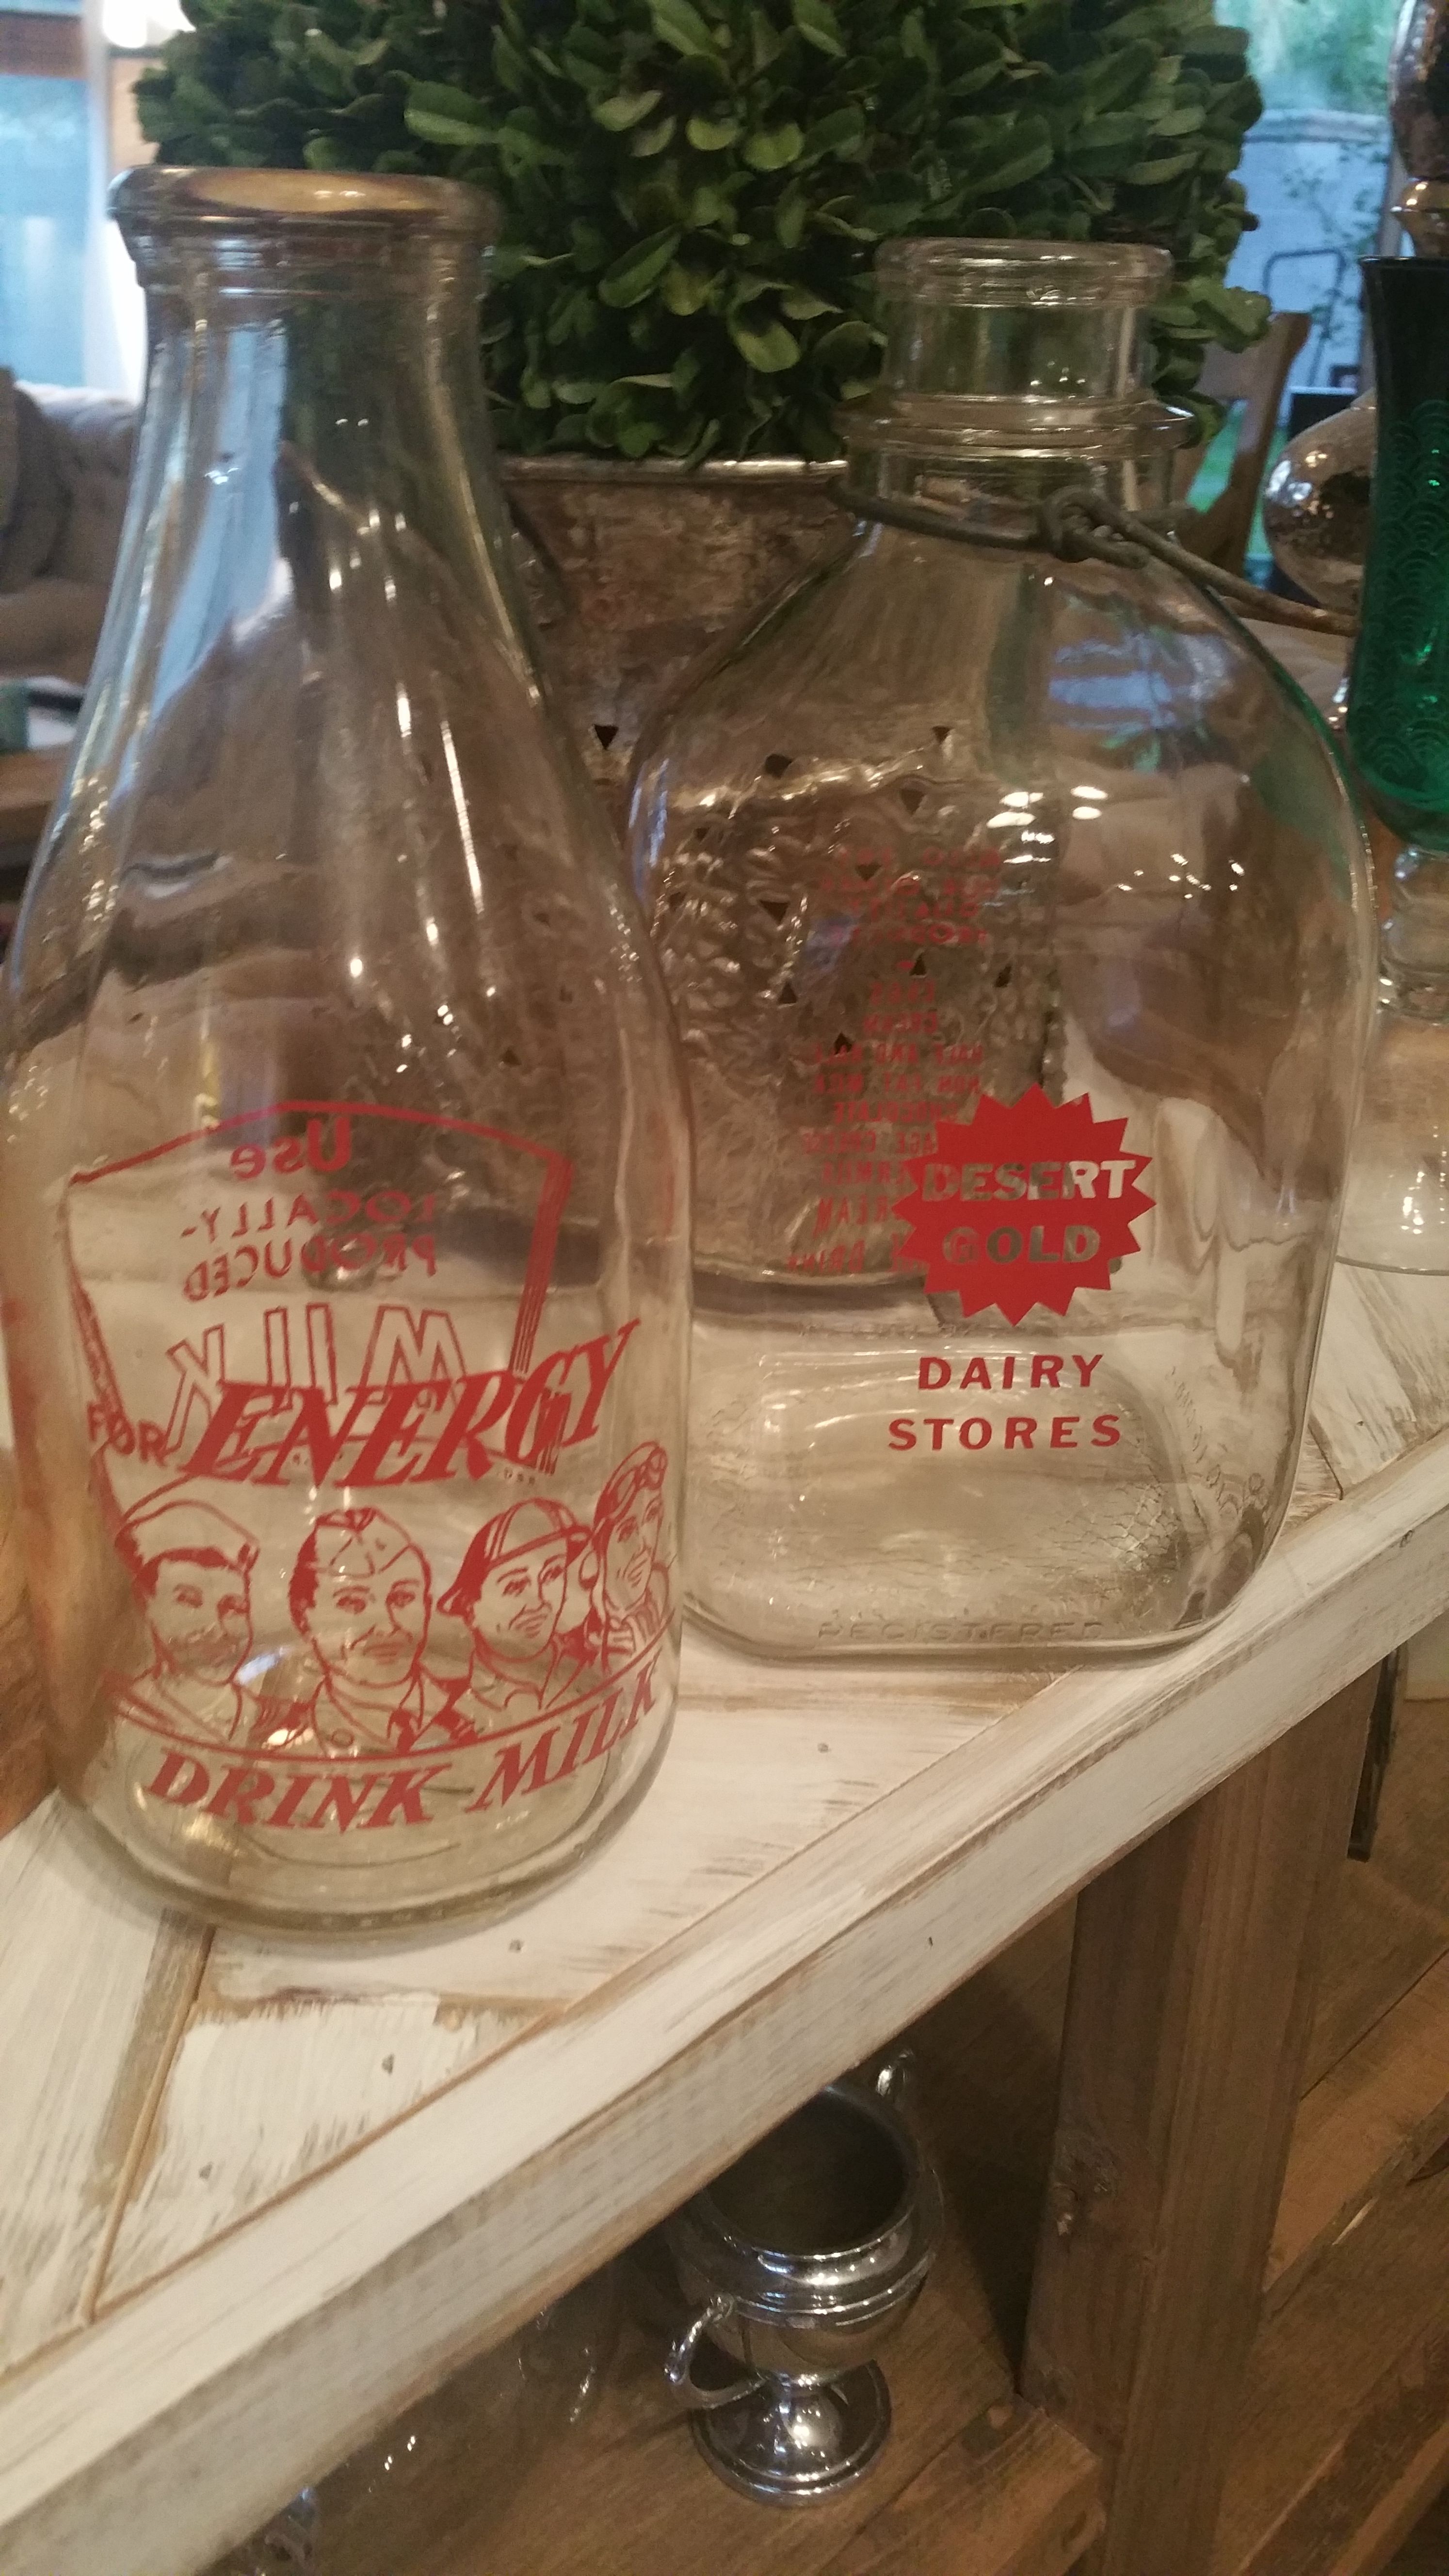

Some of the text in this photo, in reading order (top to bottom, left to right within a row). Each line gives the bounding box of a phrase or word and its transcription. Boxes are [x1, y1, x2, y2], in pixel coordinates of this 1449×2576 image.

[922, 1159, 1136, 1202] DESERT
[942, 1225, 1101, 1263] GOLD
[918, 1354, 1105, 1390] DAIRY
[86, 1318, 641, 1488] FOR ENERGY
[888, 1415, 1122, 1452] STORES
[818, 1622, 1104, 1641] REGISTERED
[144, 1660, 659, 1833] DRINK MILK
